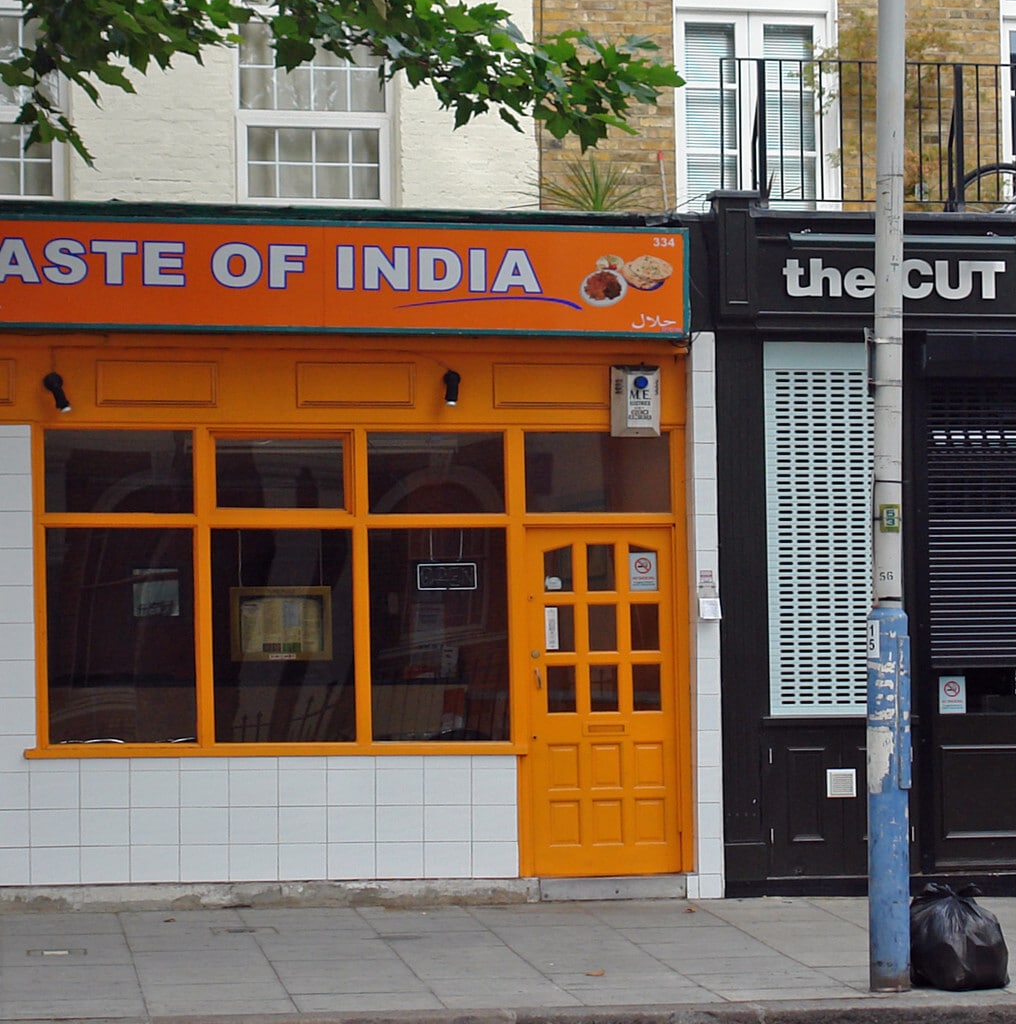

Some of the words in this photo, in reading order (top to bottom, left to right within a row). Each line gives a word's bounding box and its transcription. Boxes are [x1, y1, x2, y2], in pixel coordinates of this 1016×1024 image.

[653, 237, 675, 247] 334
[0, 237, 186, 286] ASTE
[211, 242, 307, 289] OF
[336, 244, 543, 294] INDIA
[783, 258, 876, 299] the
[902, 258, 1006, 300] CUT
[879, 571, 894, 581] 56
